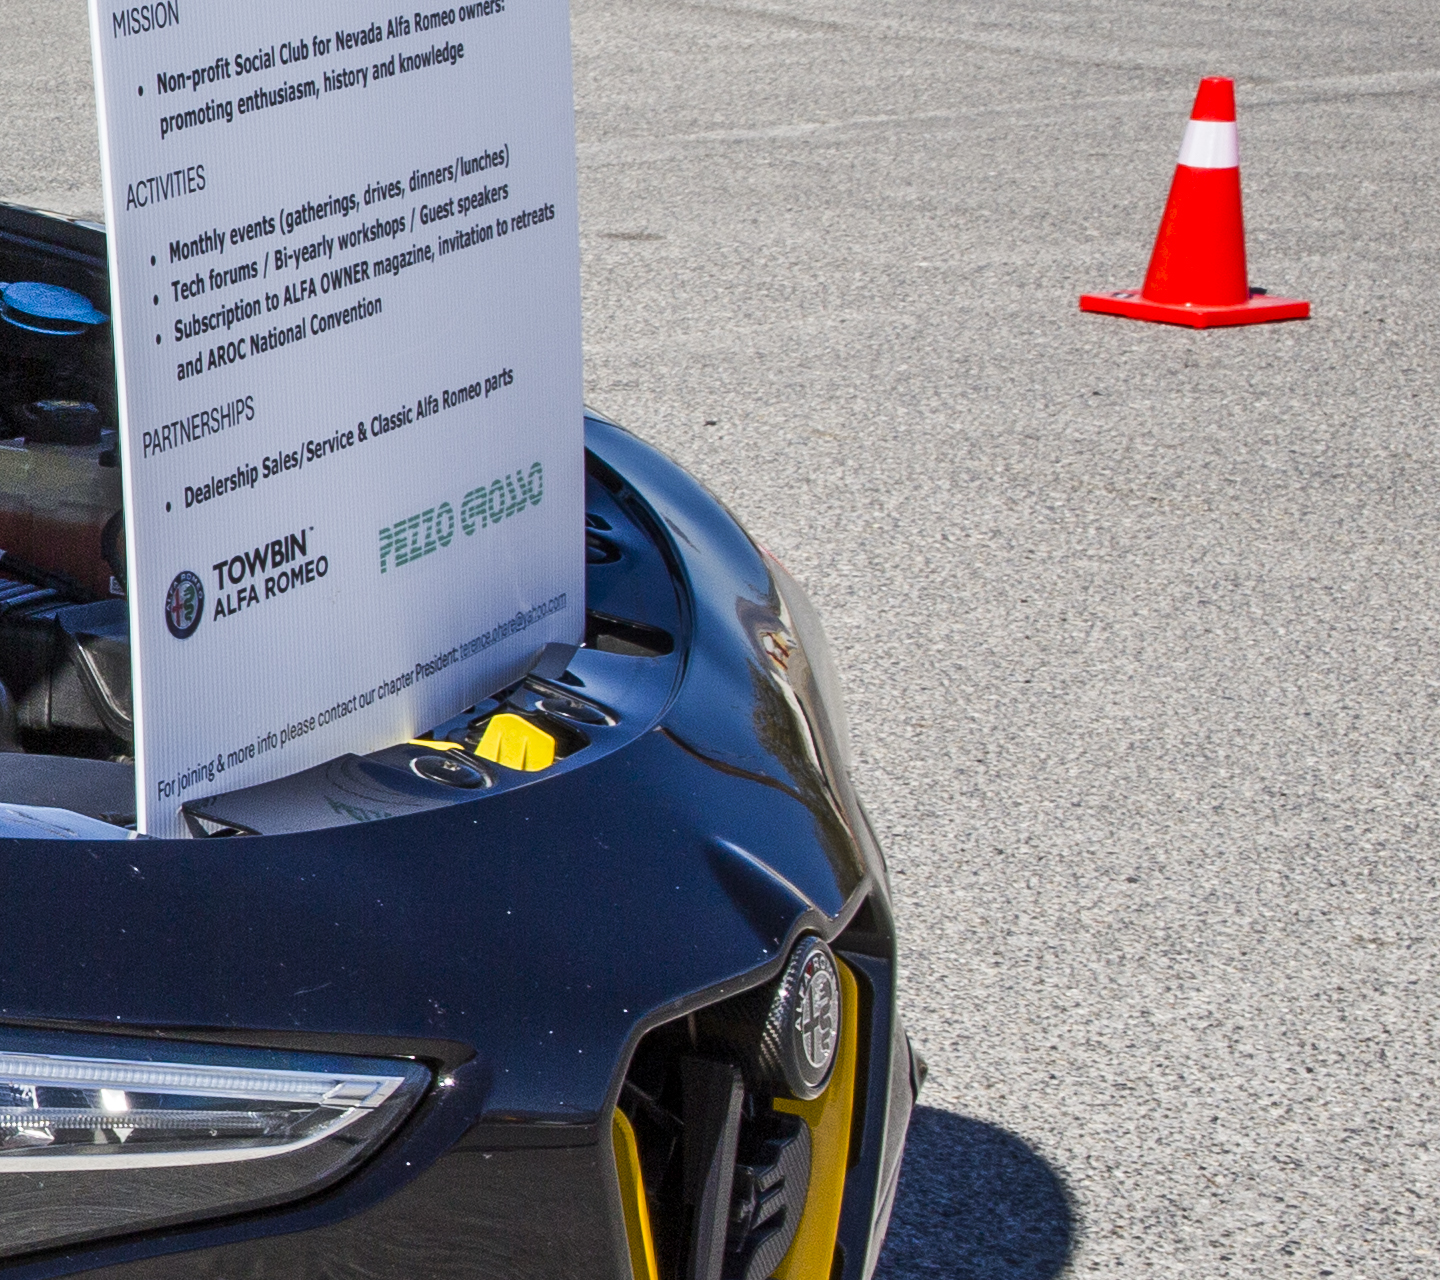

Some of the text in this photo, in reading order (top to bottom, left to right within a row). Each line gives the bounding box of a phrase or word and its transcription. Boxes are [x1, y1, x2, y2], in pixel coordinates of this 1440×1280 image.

[112, 0, 179, 39] MISSION
[157, 55, 231, 95] Non-profit
[234, 45, 276, 75] Social
[279, 36, 309, 66] Club
[312, 32, 332, 56] for
[336, 23, 383, 52] Nevada
[386, 13, 411, 40] Alfa
[414, 7, 456, 33] Romeo
[160, 41, 465, 139] promoting enthusiasm, history and knowledge
[126, 163, 206, 211] ACTIVITIES
[168, 143, 510, 264] Monthly events (gatherings, drives, dinners/lunches)
[171, 274, 206, 304] Tech
[209, 259, 259, 291] forums
[274, 235, 334, 271] Bi-yearly
[337, 216, 407, 252] workshops
[419, 198, 455, 226] Guest
[457, 181, 510, 218] speakers
[174, 201, 556, 343] Subscription to ALFA OWNER magazine, invitation to retreats
[176, 296, 383, 381] and AROC National Convention
[142, 395, 255, 458] PARTNERSHIPS
[184, 366, 514, 508] Dealership Sales/Service & Classic Alfa Romeo parts
[212, 528, 308, 591] TOWBIN
[379, 501, 454, 574] PEZZO
[213, 555, 329, 622] ALFA ROMEO
[157, 780, 176, 802] For
[176, 761, 215, 797] joining
[216, 753, 226, 773] &
[226, 742, 256, 769] more
[257, 730, 278, 755] info
[279, 716, 316, 749] please
[317, 694, 358, 728] contact
[358, 688, 376, 709] our
[377, 669, 415, 700] chapter
[415, 646, 460, 683] President:
